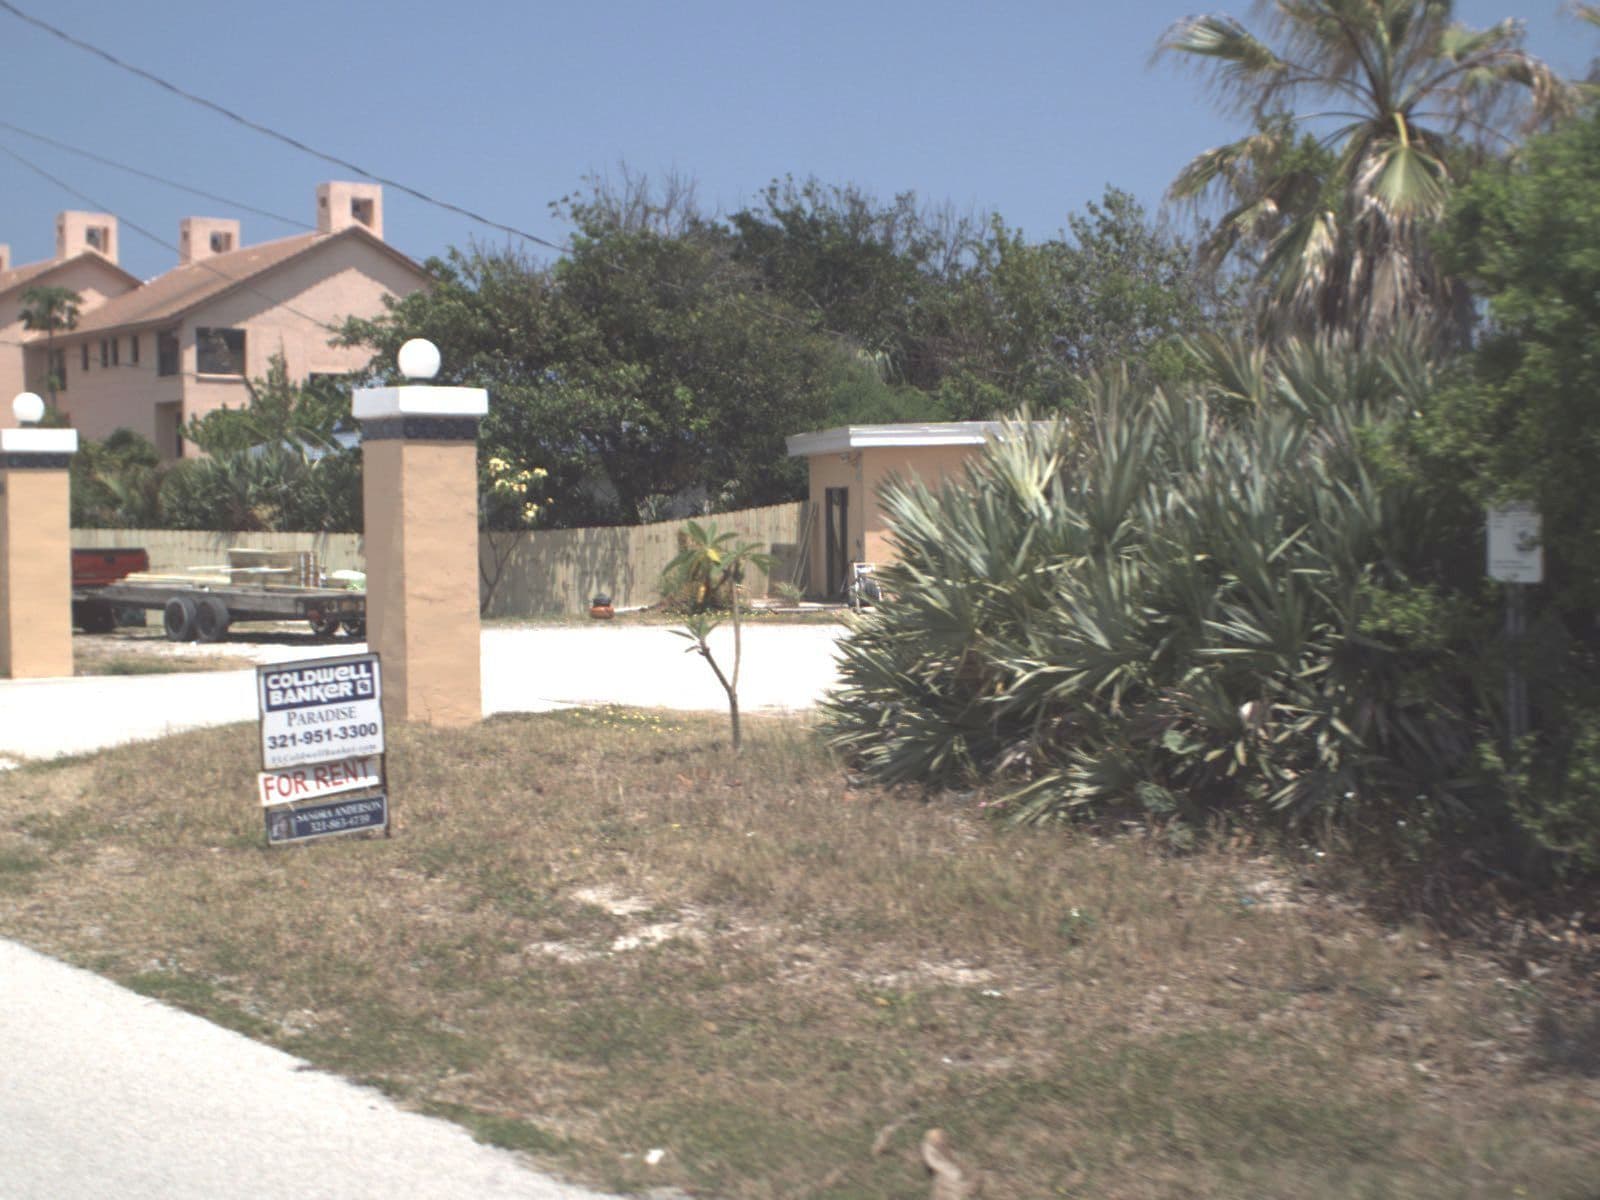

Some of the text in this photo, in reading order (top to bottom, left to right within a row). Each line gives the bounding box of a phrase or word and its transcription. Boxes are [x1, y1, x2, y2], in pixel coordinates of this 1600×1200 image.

[287, 706, 357, 727] PARADISE
[267, 723, 378, 750] 321-951-3300
[263, 758, 370, 800] FOR RENT
